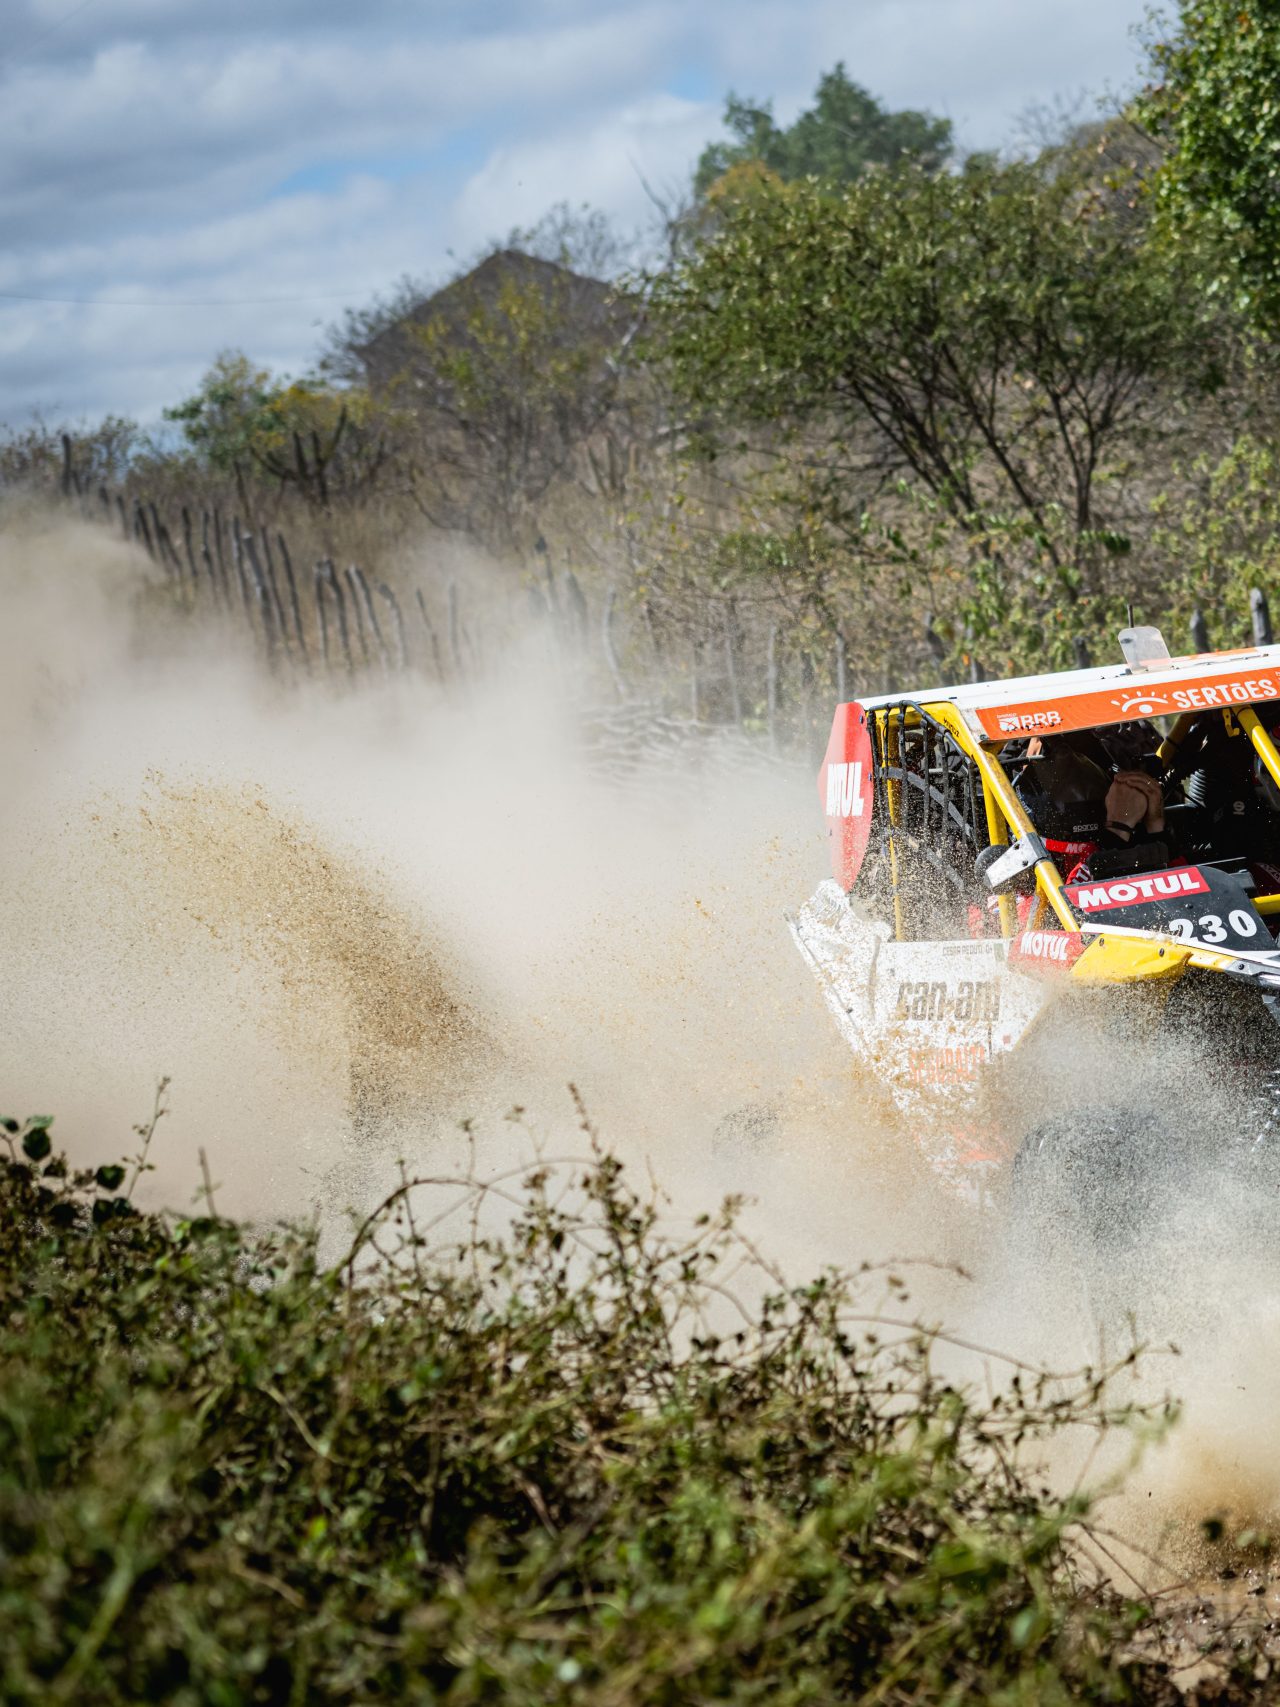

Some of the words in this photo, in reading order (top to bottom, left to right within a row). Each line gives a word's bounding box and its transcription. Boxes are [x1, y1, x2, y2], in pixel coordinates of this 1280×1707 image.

[1021, 711, 1061, 730] BRB
[826, 761, 864, 817] MTUL
[1078, 872, 1201, 909] MOTUL
[1169, 909, 1257, 943] 230
[1020, 931, 1070, 960] MOTUL
